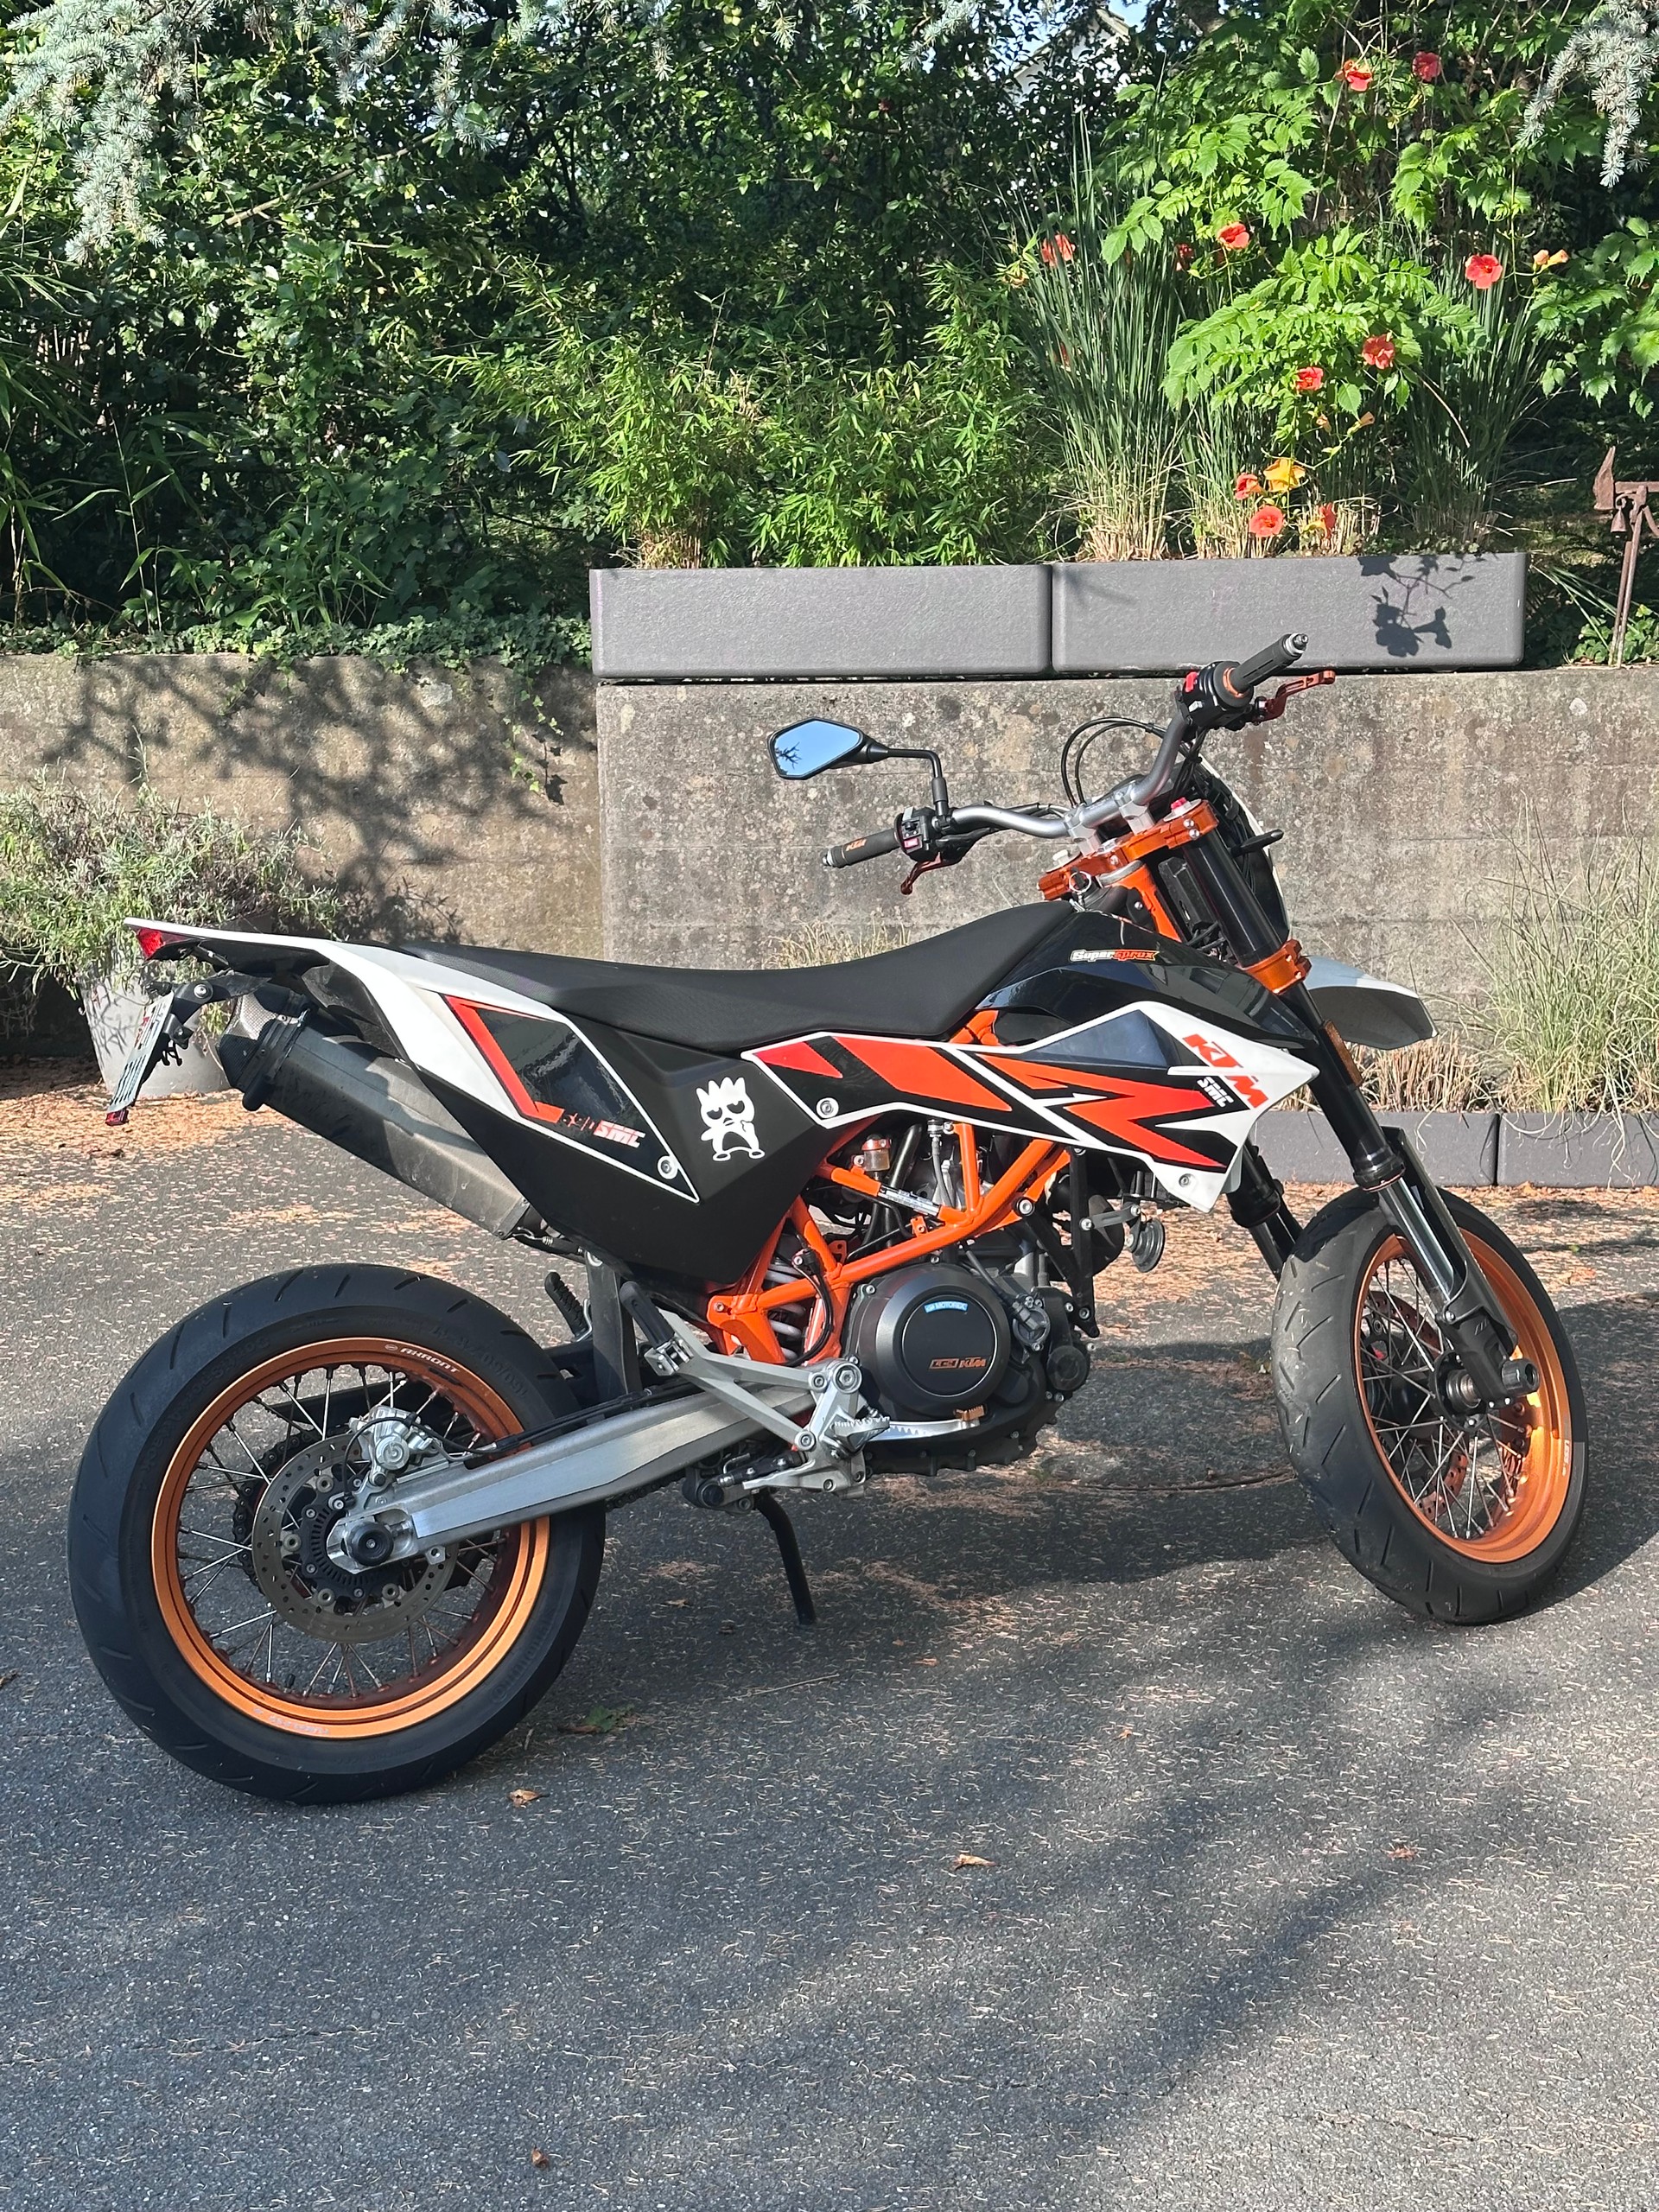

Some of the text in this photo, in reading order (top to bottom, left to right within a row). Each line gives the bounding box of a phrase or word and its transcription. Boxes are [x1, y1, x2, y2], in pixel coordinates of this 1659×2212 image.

[1071, 950, 1157, 963] Supersprox
[1181, 1033, 1269, 1109] KTM
[1196, 1075, 1235, 1108] SMC
[593, 1119, 646, 1148] SMC
[958, 1357, 987, 1369] KTM
